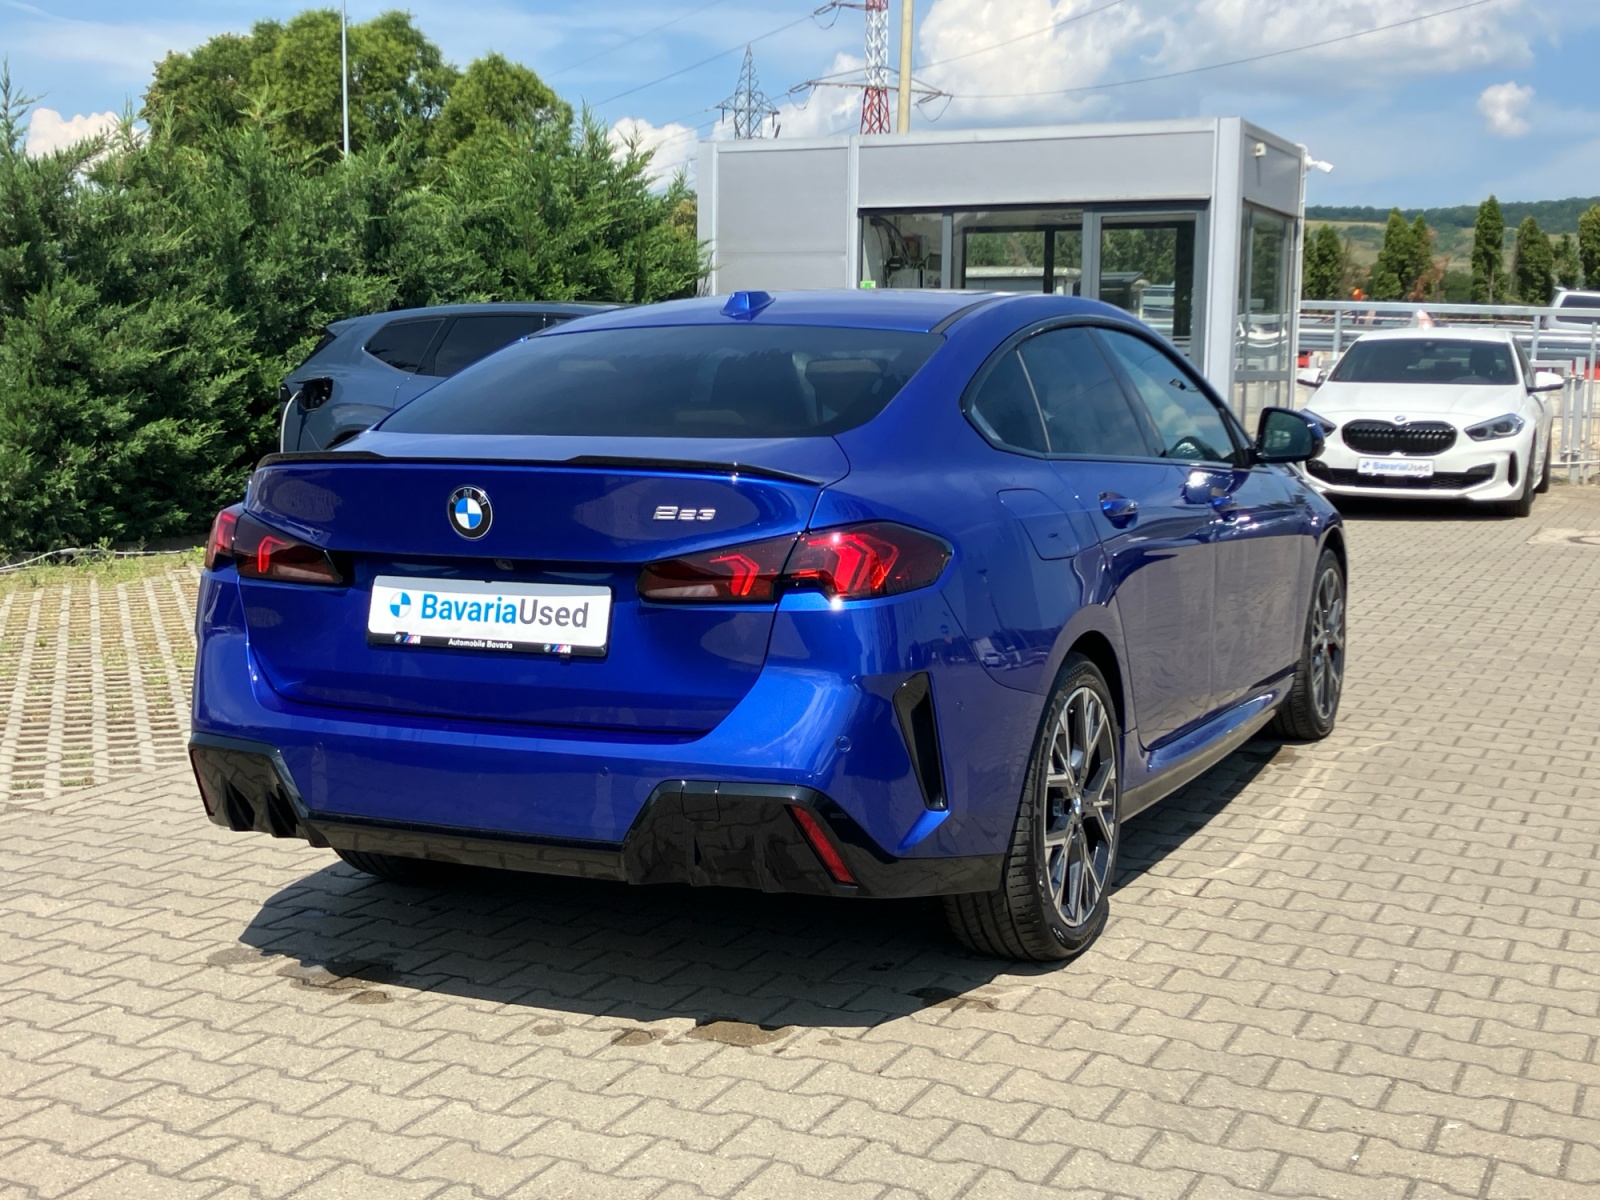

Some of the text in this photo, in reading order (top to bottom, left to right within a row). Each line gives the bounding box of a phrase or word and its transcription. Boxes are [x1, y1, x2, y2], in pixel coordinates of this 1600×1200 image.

[1373, 462, 1430, 472] BavariaUsed
[451, 489, 487, 506] BMW
[421, 593, 589, 628] BavariaUsed
[448, 638, 513, 649] Automobile Bavaria
